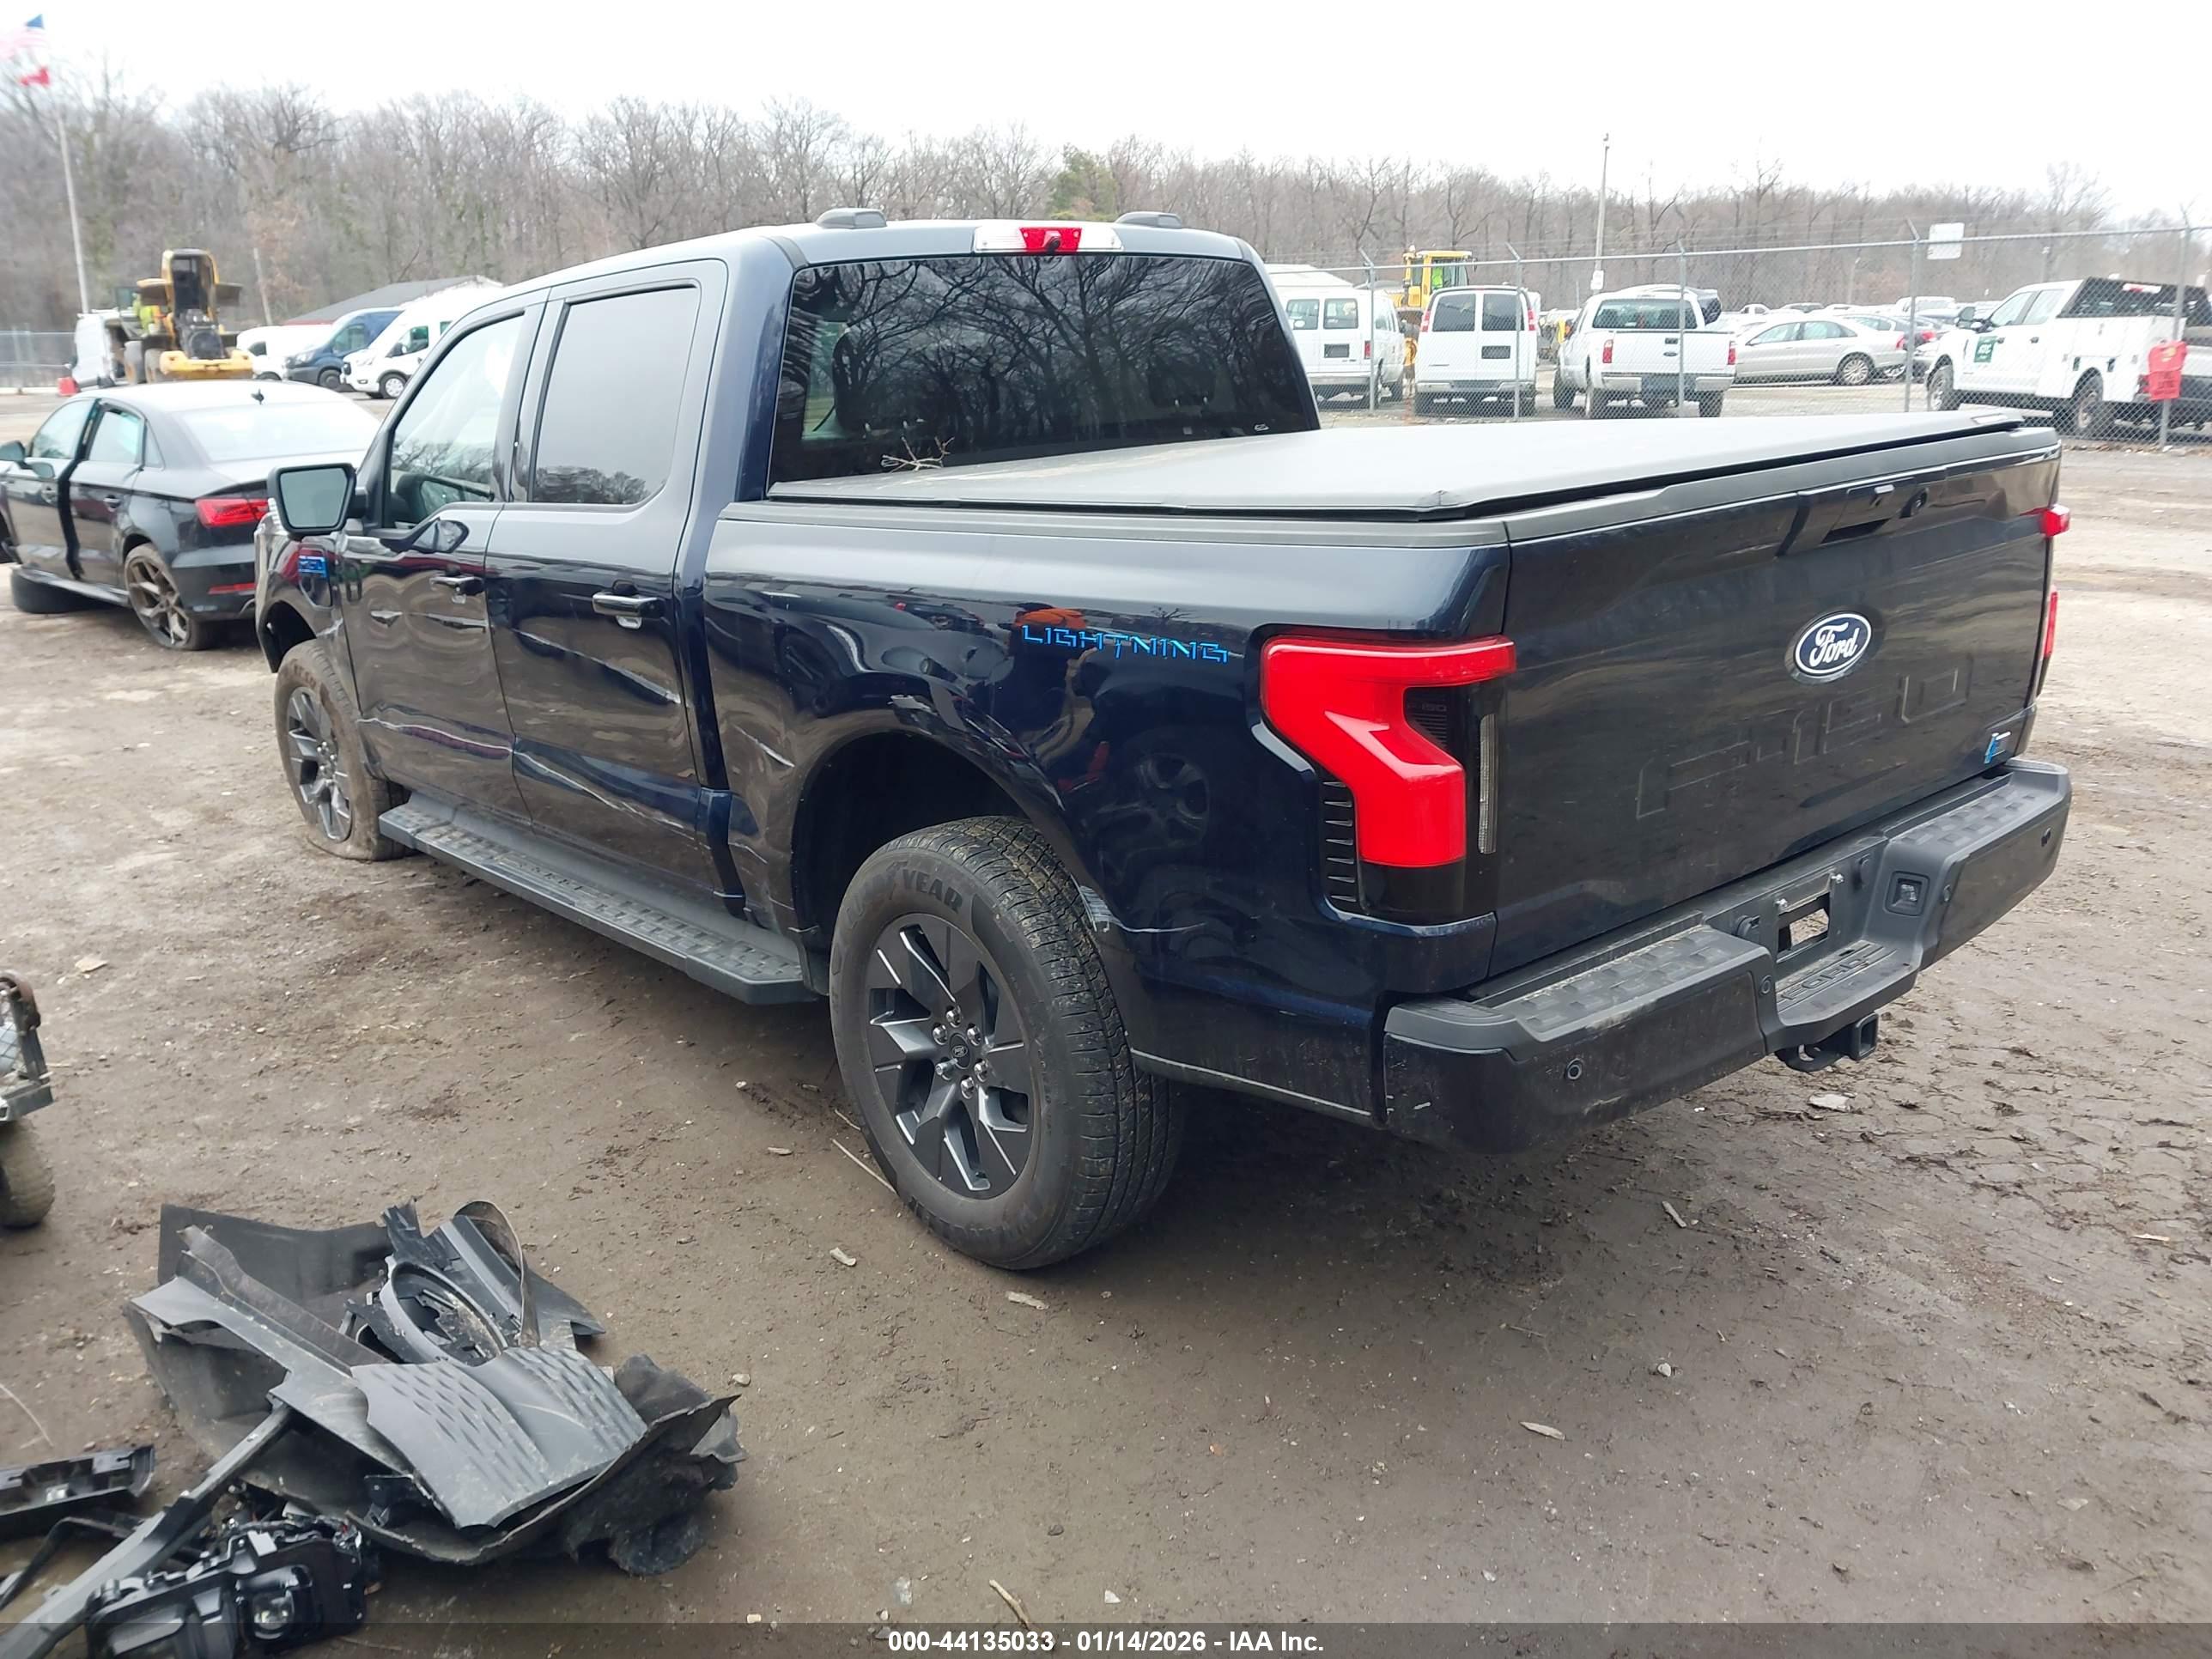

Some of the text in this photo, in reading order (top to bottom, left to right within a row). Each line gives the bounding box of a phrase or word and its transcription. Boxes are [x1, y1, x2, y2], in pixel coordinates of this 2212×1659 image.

[1022, 624, 1231, 665] LIGHTNING
[1808, 622, 1861, 667] Ford
[1779, 957, 1868, 1000] FORD
